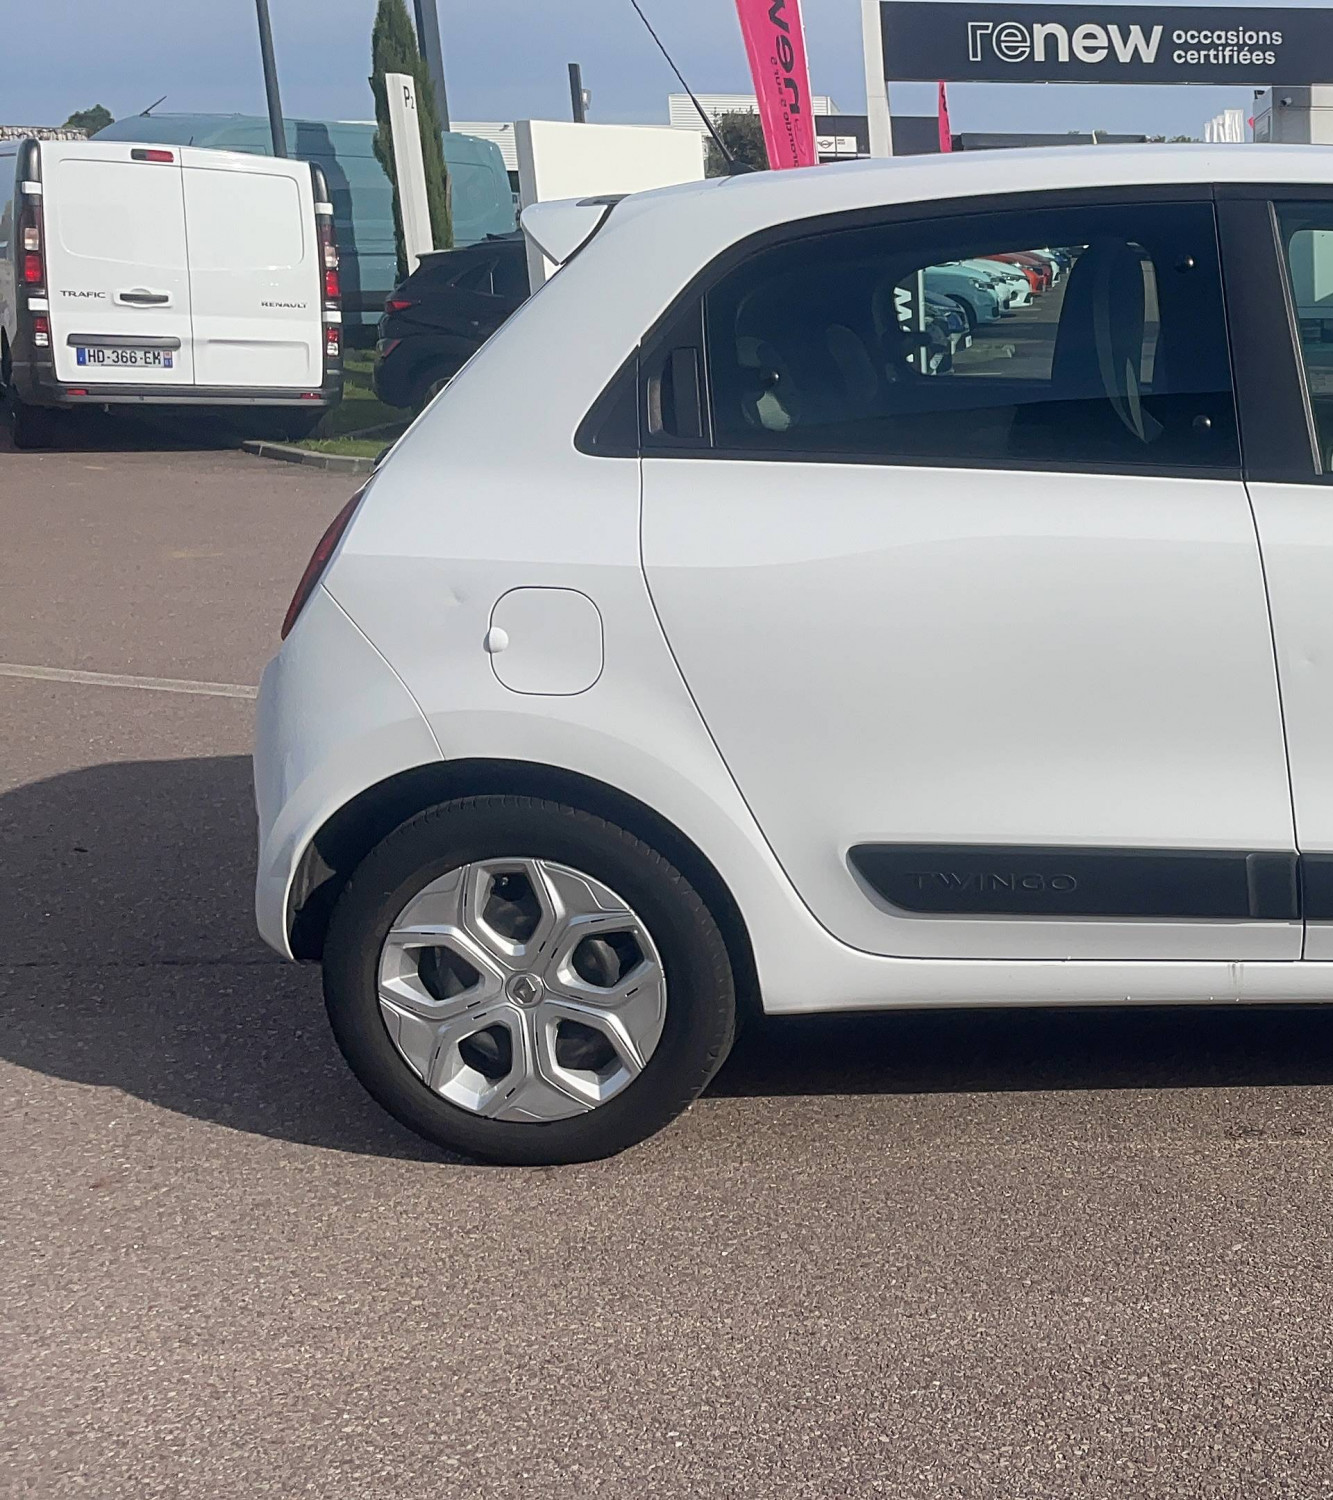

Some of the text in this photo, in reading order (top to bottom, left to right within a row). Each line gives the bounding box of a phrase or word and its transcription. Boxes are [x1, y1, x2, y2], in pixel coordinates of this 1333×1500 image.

[967, 21, 1164, 64] renew
[1172, 26, 1284, 46] occasions
[1172, 46, 1277, 65] certifiées
[60, 290, 106, 299] TRAFIC
[261, 301, 308, 309] RENAULT
[904, 871, 1078, 893] TWINGO
